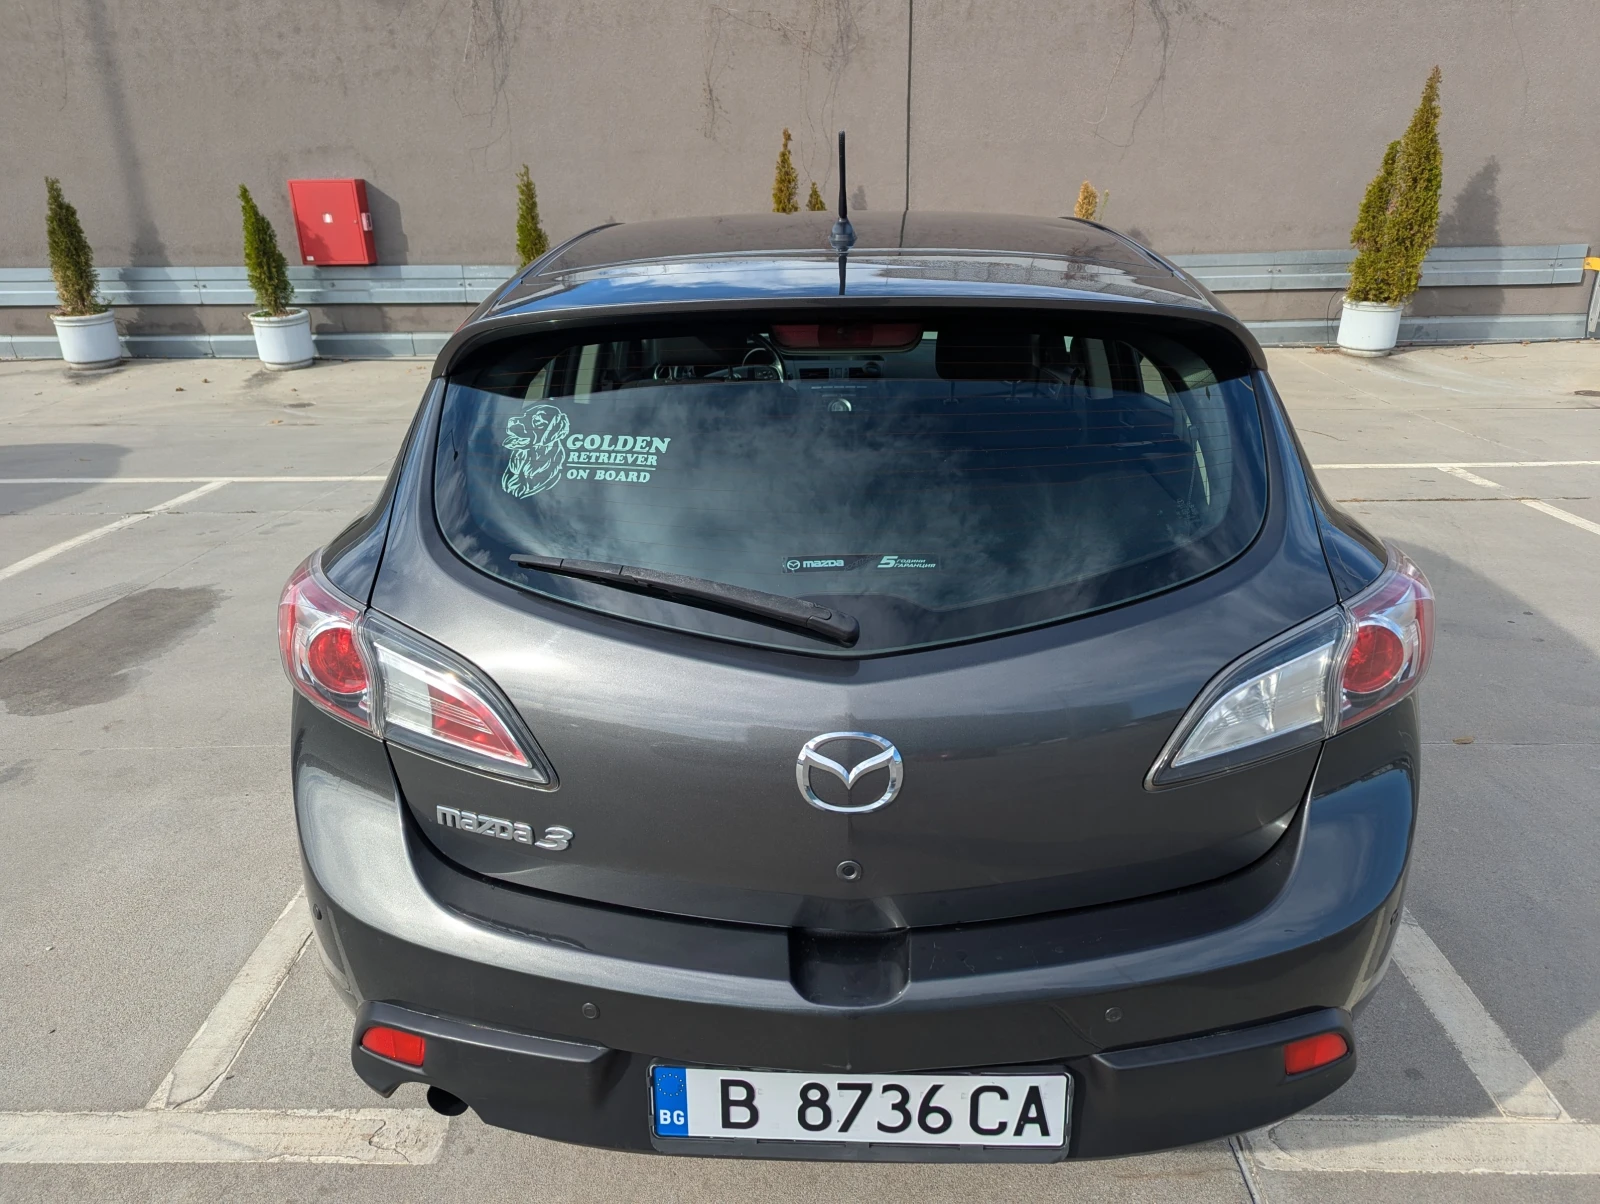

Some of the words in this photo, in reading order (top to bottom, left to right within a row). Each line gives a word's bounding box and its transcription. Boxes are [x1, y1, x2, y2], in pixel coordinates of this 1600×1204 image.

[566, 434, 671, 453] GOLDEN
[567, 451, 658, 466] RETRIEVER
[566, 469, 590, 480] ON
[594, 470, 651, 483] BOARD
[803, 559, 845, 568] mazda
[877, 555, 899, 568] 5
[436, 804, 535, 846] mazda
[534, 824, 575, 851] 3
[720, 1079, 760, 1130] B
[796, 1082, 953, 1136] 8736
[969, 1085, 1051, 1137] CA
[659, 1109, 686, 1126] BG
